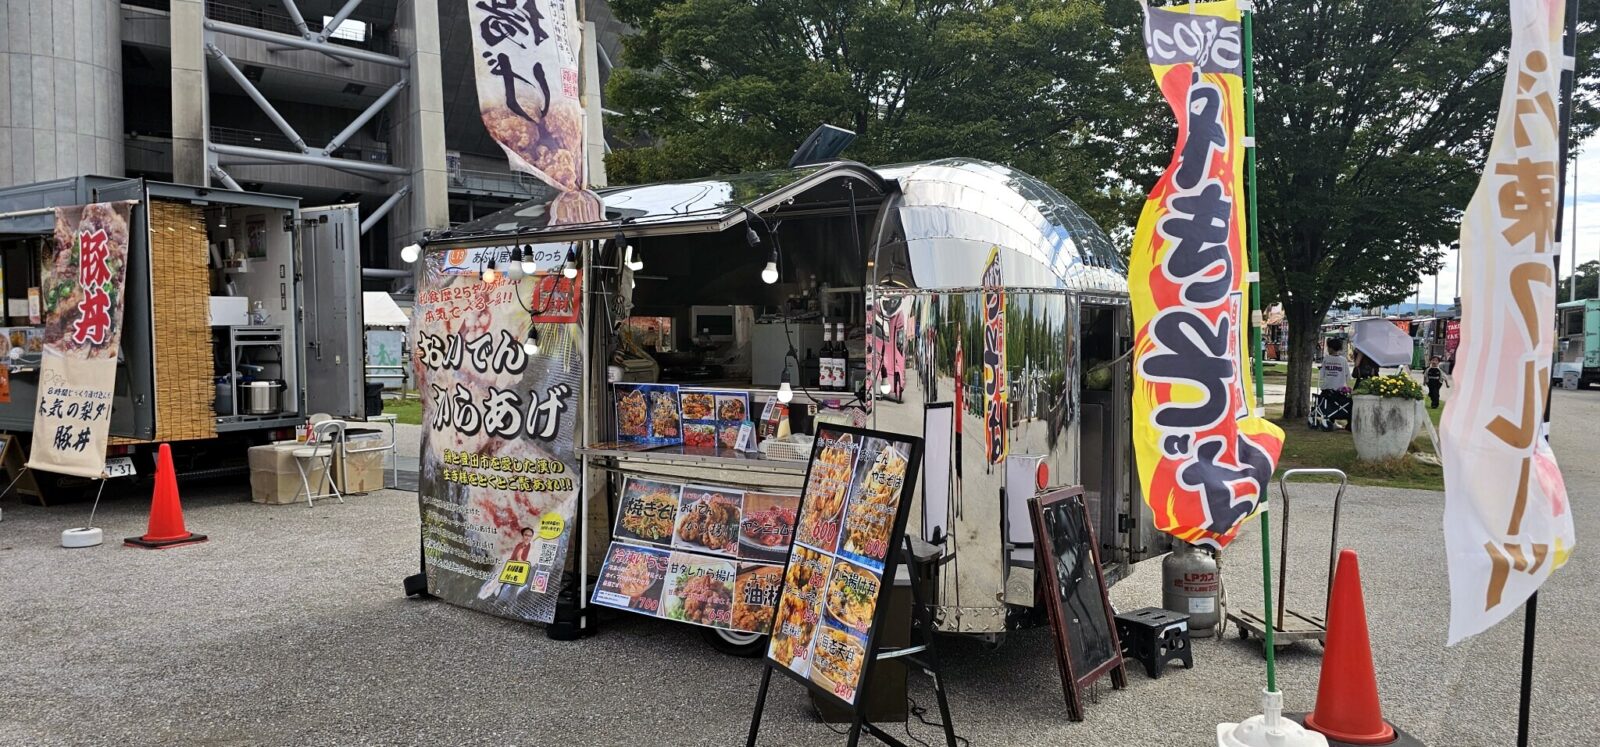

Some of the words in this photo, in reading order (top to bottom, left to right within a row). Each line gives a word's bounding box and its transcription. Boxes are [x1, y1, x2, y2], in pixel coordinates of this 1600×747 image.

[74, 229, 112, 345] 豚丼
[432, 383, 573, 440] からあげ
[53, 424, 91, 453] 豚丼
[812, 520, 838, 544] 600
[638, 596, 659, 611] 700
[708, 608, 732, 623] 650
[833, 681, 853, 700] 880
